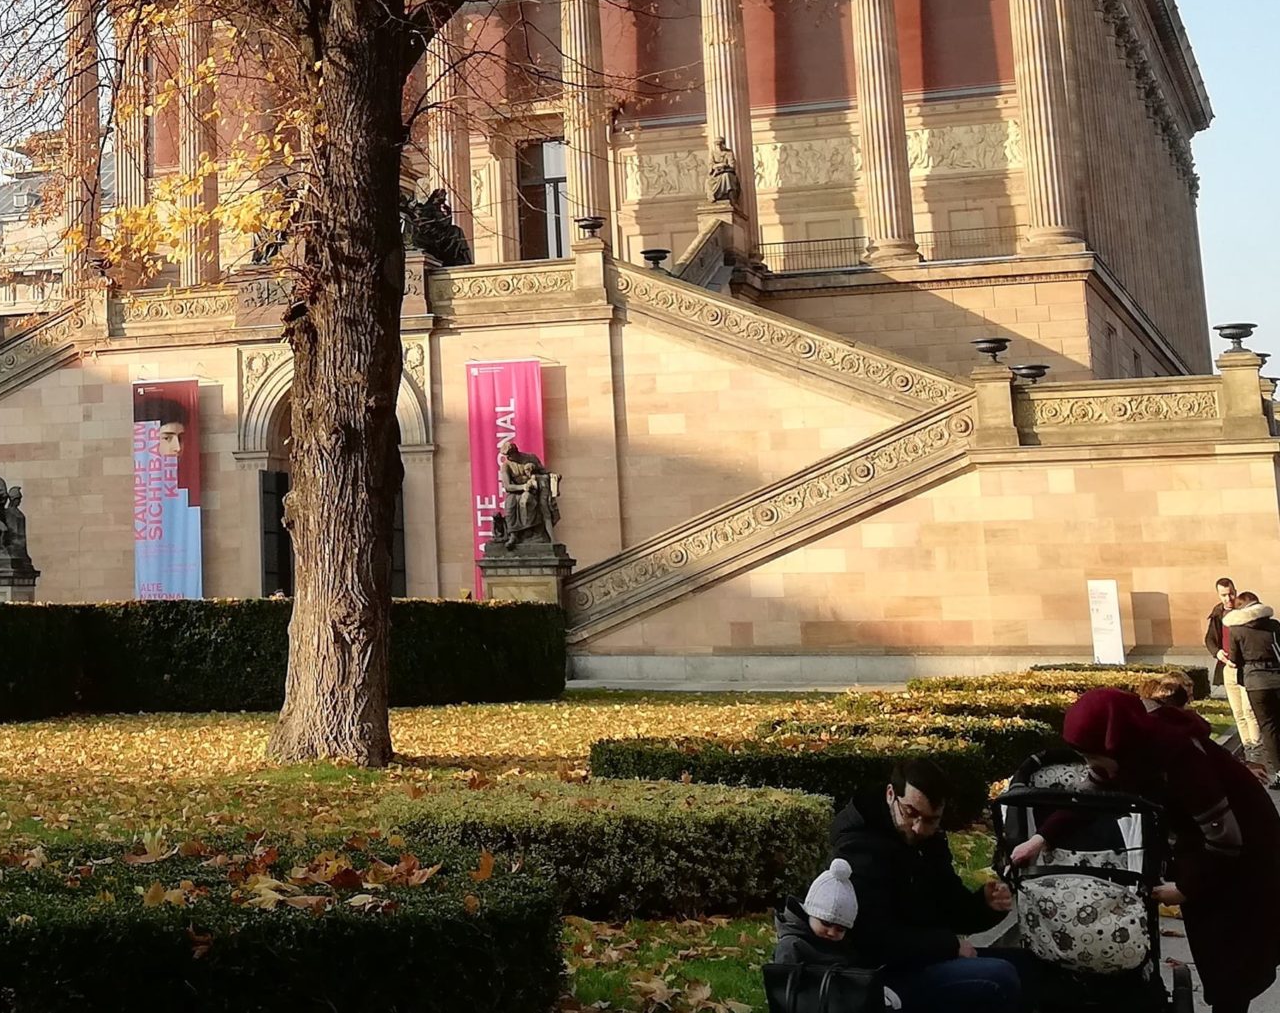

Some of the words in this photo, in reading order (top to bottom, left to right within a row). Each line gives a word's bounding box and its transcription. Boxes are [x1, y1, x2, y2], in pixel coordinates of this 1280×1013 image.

[134, 460, 147, 541] KAMPF
[148, 420, 163, 541] SICHTBAR-
[140, 582, 163, 592] ALTE
